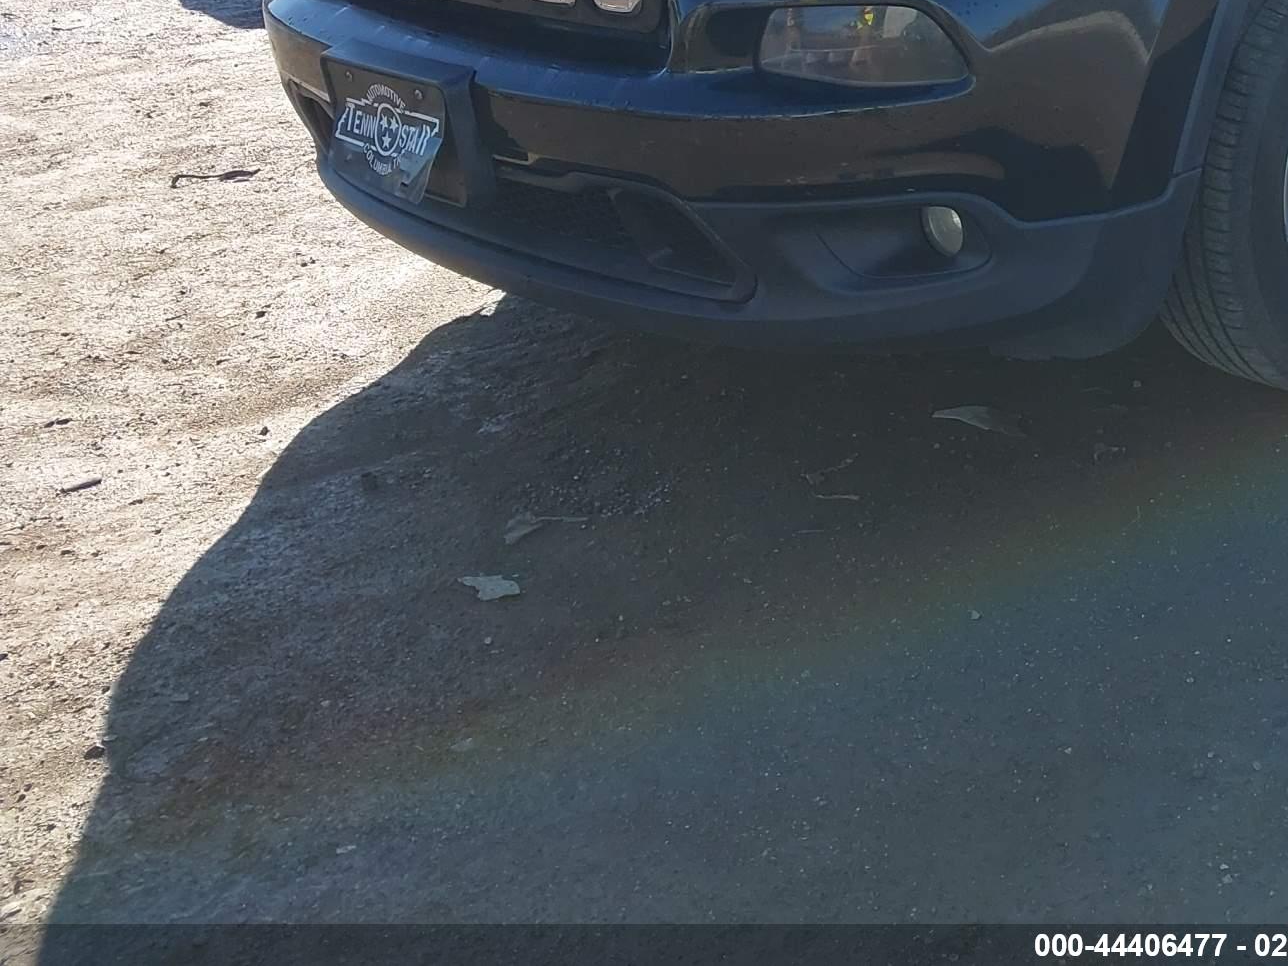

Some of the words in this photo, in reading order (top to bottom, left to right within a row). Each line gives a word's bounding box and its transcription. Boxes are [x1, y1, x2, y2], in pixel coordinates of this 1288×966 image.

[366, 83, 406, 114] AUTOMOTIVE
[345, 101, 377, 139] TENN
[363, 143, 393, 176] COLUMBIA
